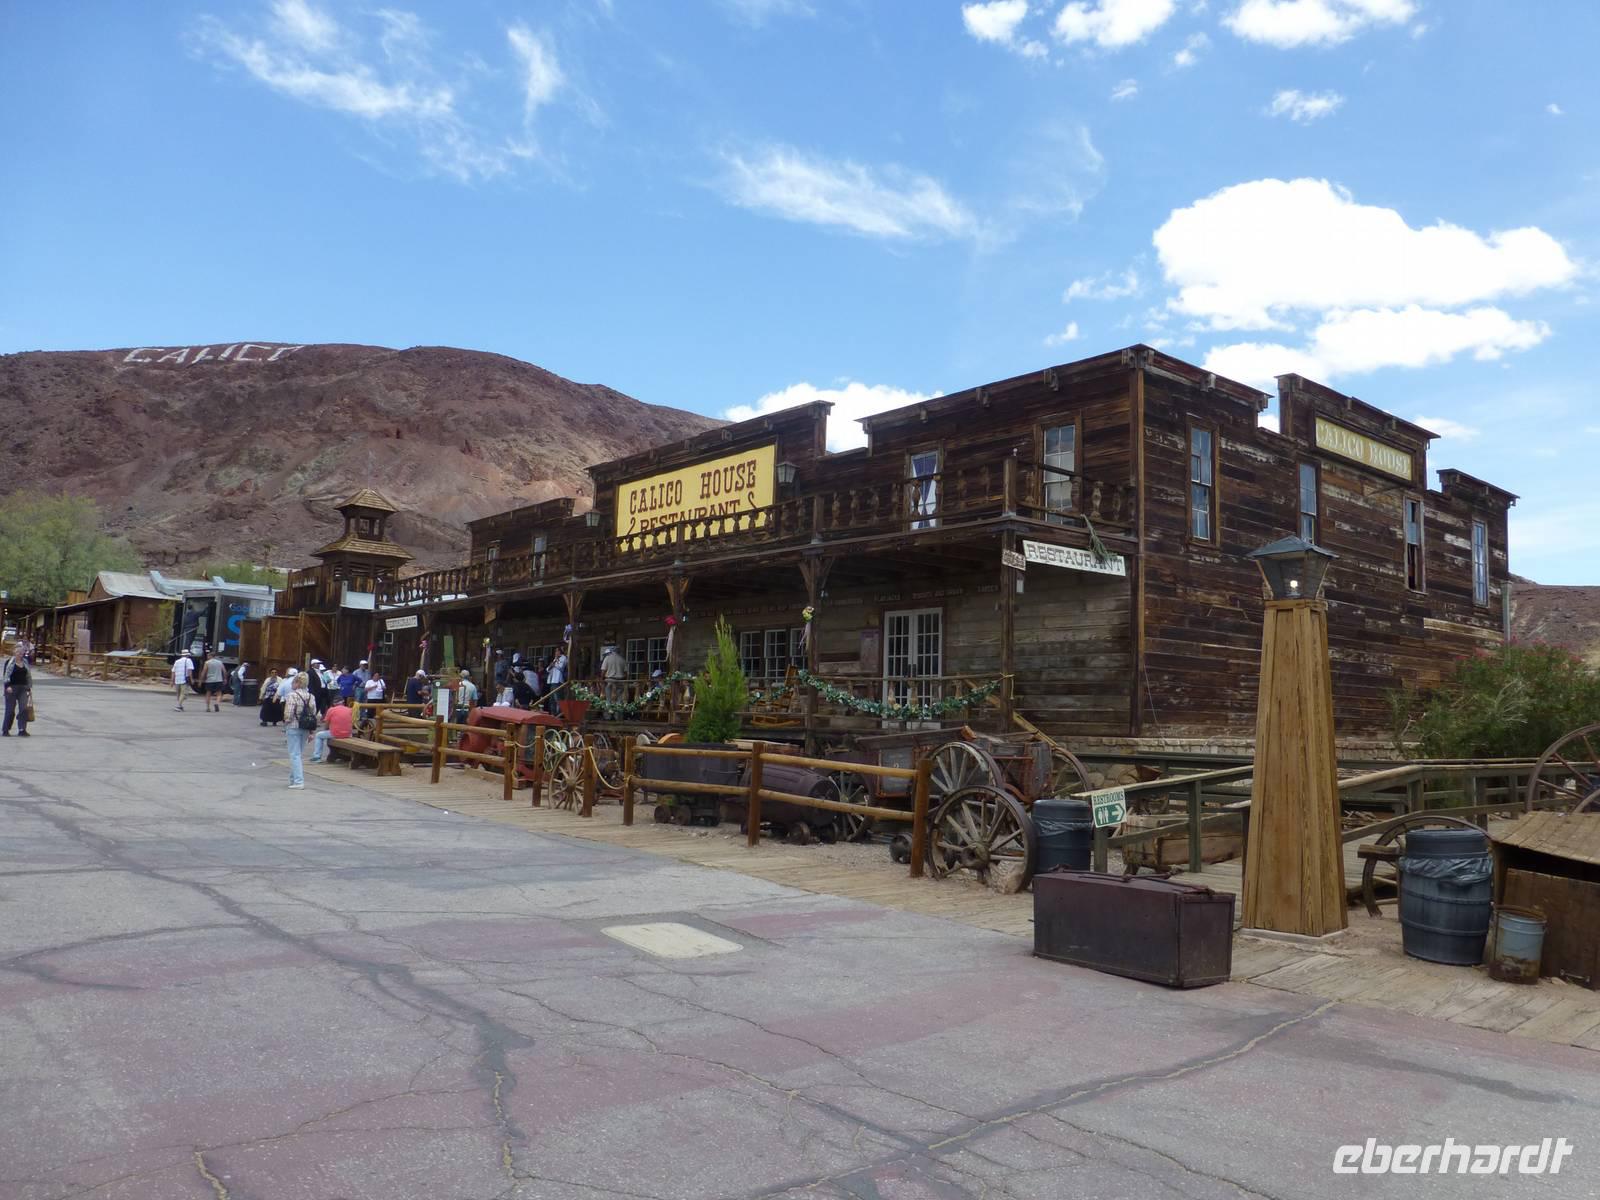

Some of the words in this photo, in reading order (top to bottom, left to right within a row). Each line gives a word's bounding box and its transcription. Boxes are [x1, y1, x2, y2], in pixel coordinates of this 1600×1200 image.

[1317, 423, 1364, 459] CALICO
[1368, 441, 1409, 476] HOUSE
[629, 479, 683, 515] CALICO
[699, 459, 757, 499] HOUSE
[1026, 543, 1123, 572] RESTAURANT
[1093, 791, 1124, 804] RESTROOMS
